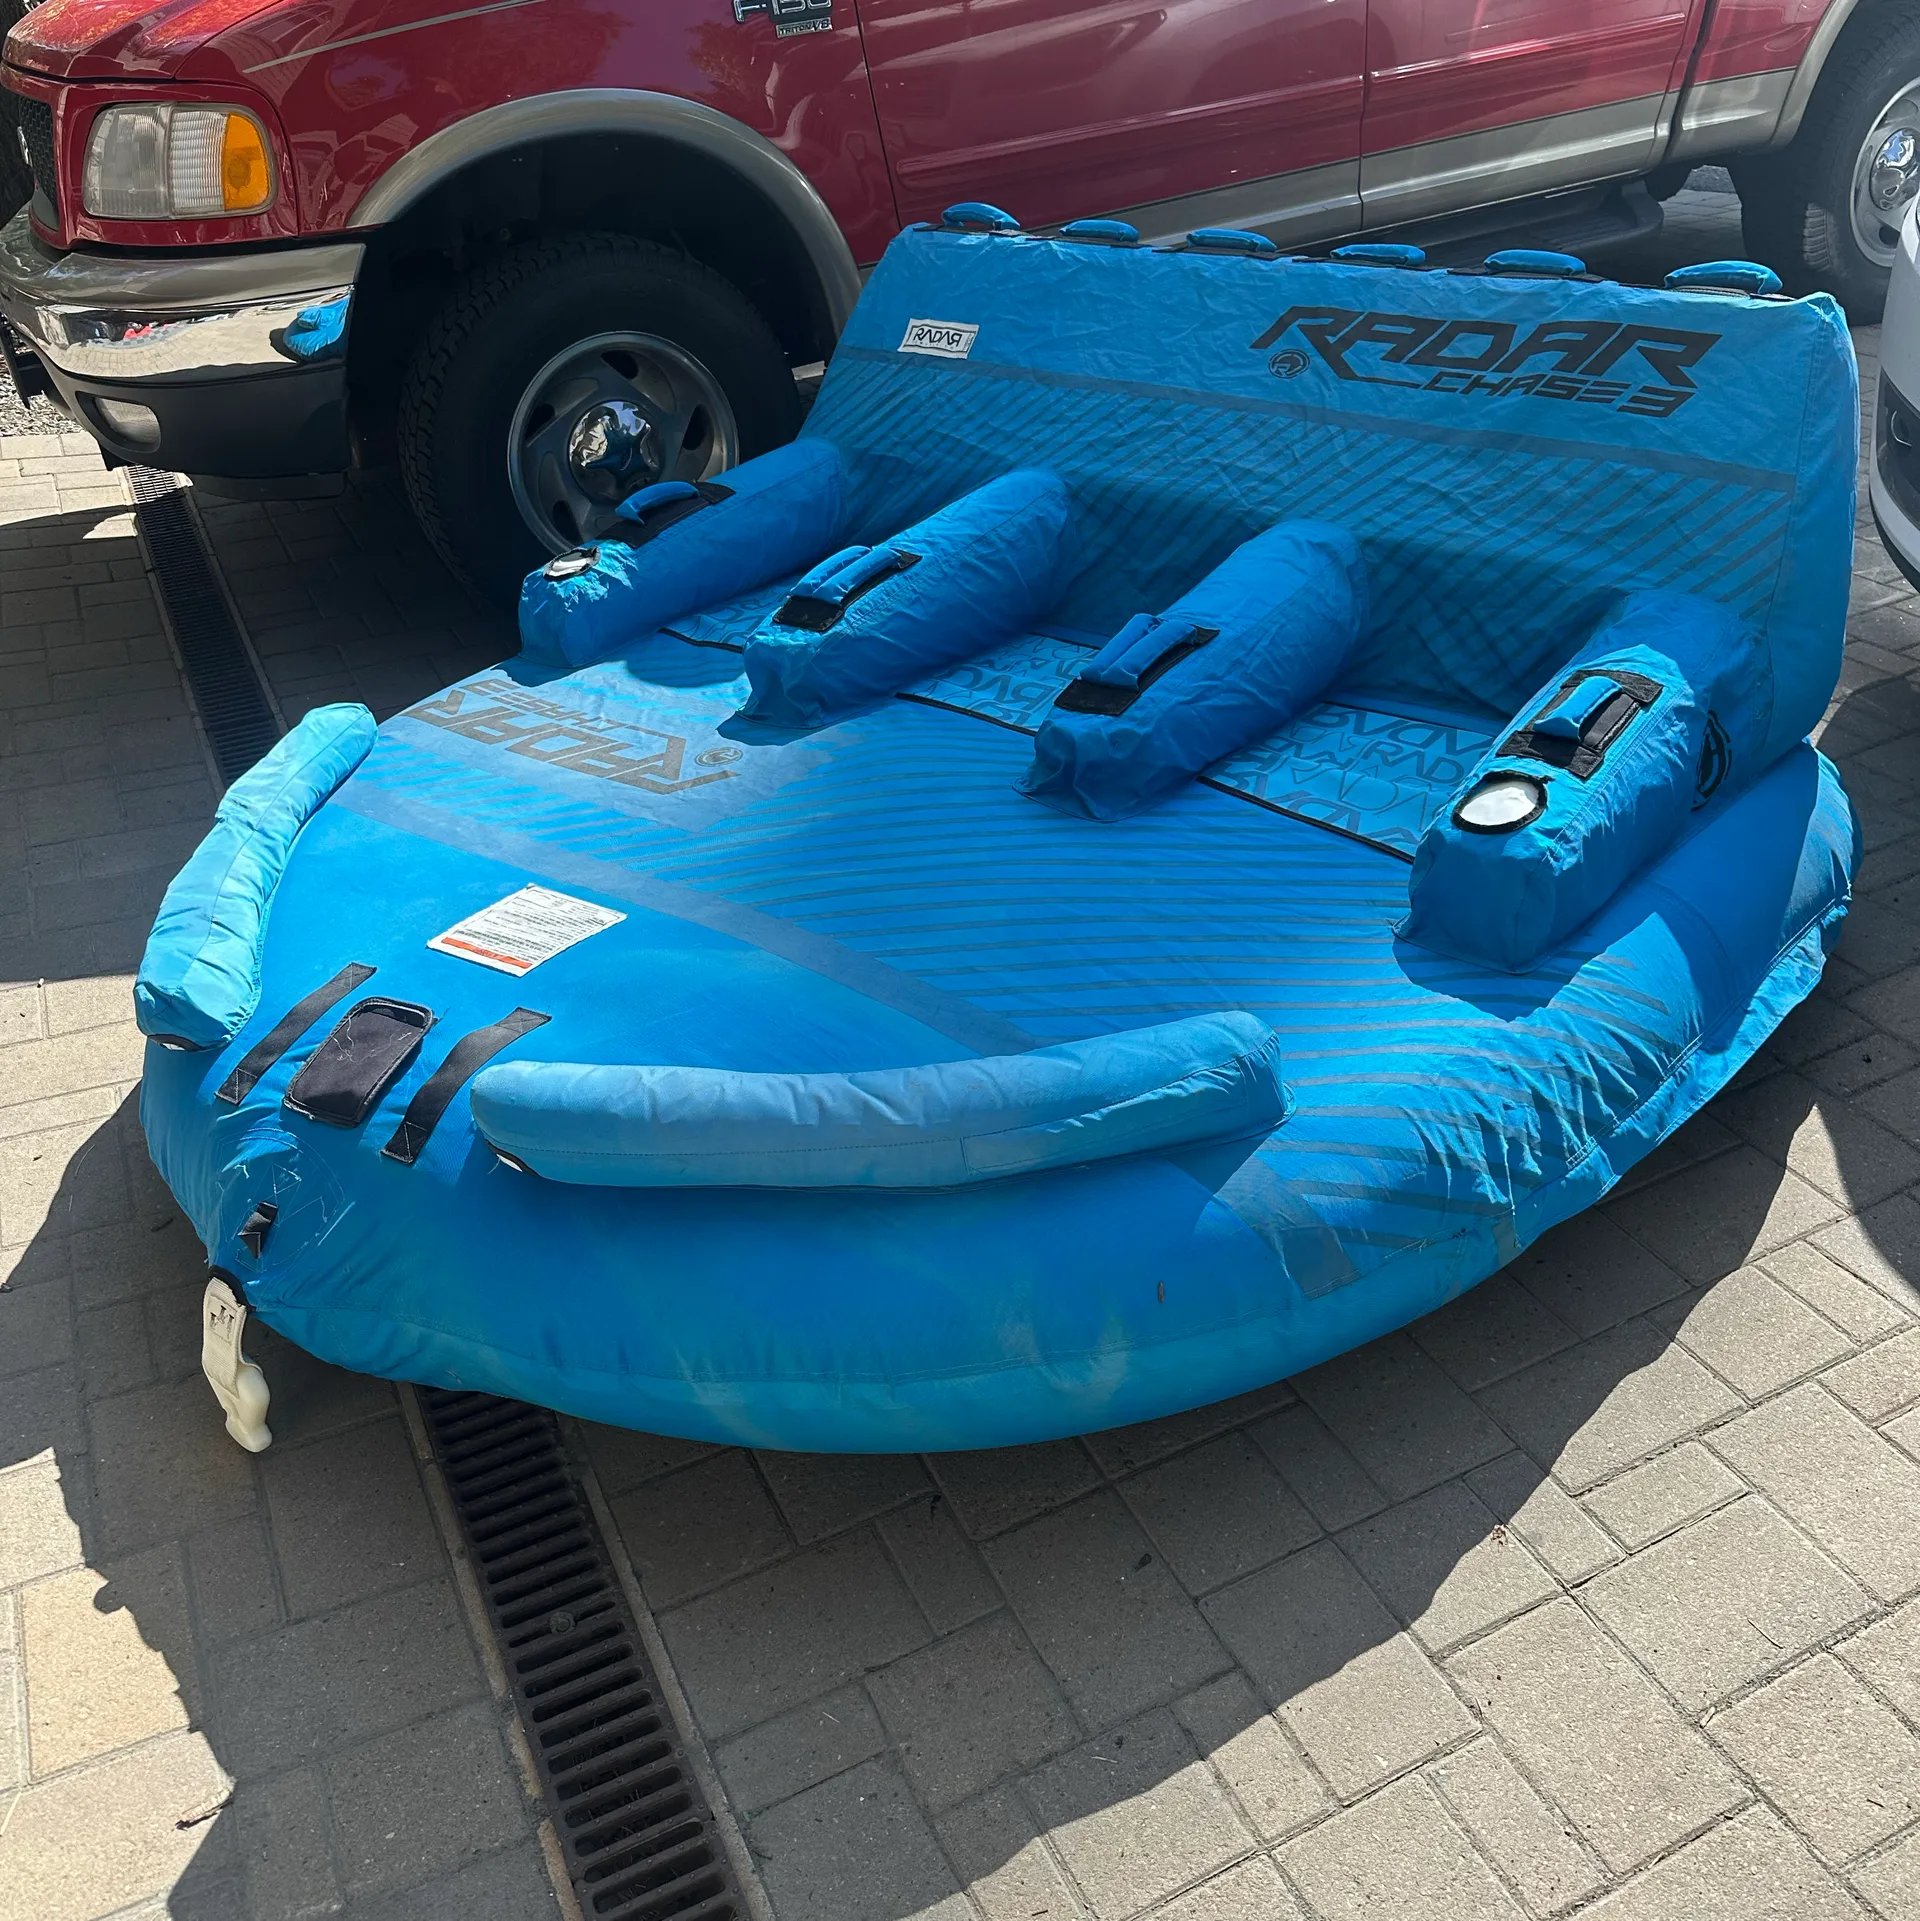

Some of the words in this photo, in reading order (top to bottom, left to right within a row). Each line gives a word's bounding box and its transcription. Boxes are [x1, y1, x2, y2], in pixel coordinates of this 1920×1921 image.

[734, 0, 832, 22] F-15
[913, 327, 963, 347] RADAR
[1249, 305, 1723, 389] RADAR
[1421, 371, 1632, 404] CHASE
[1616, 386, 1697, 418] 3
[403, 689, 741, 795] RADAR
